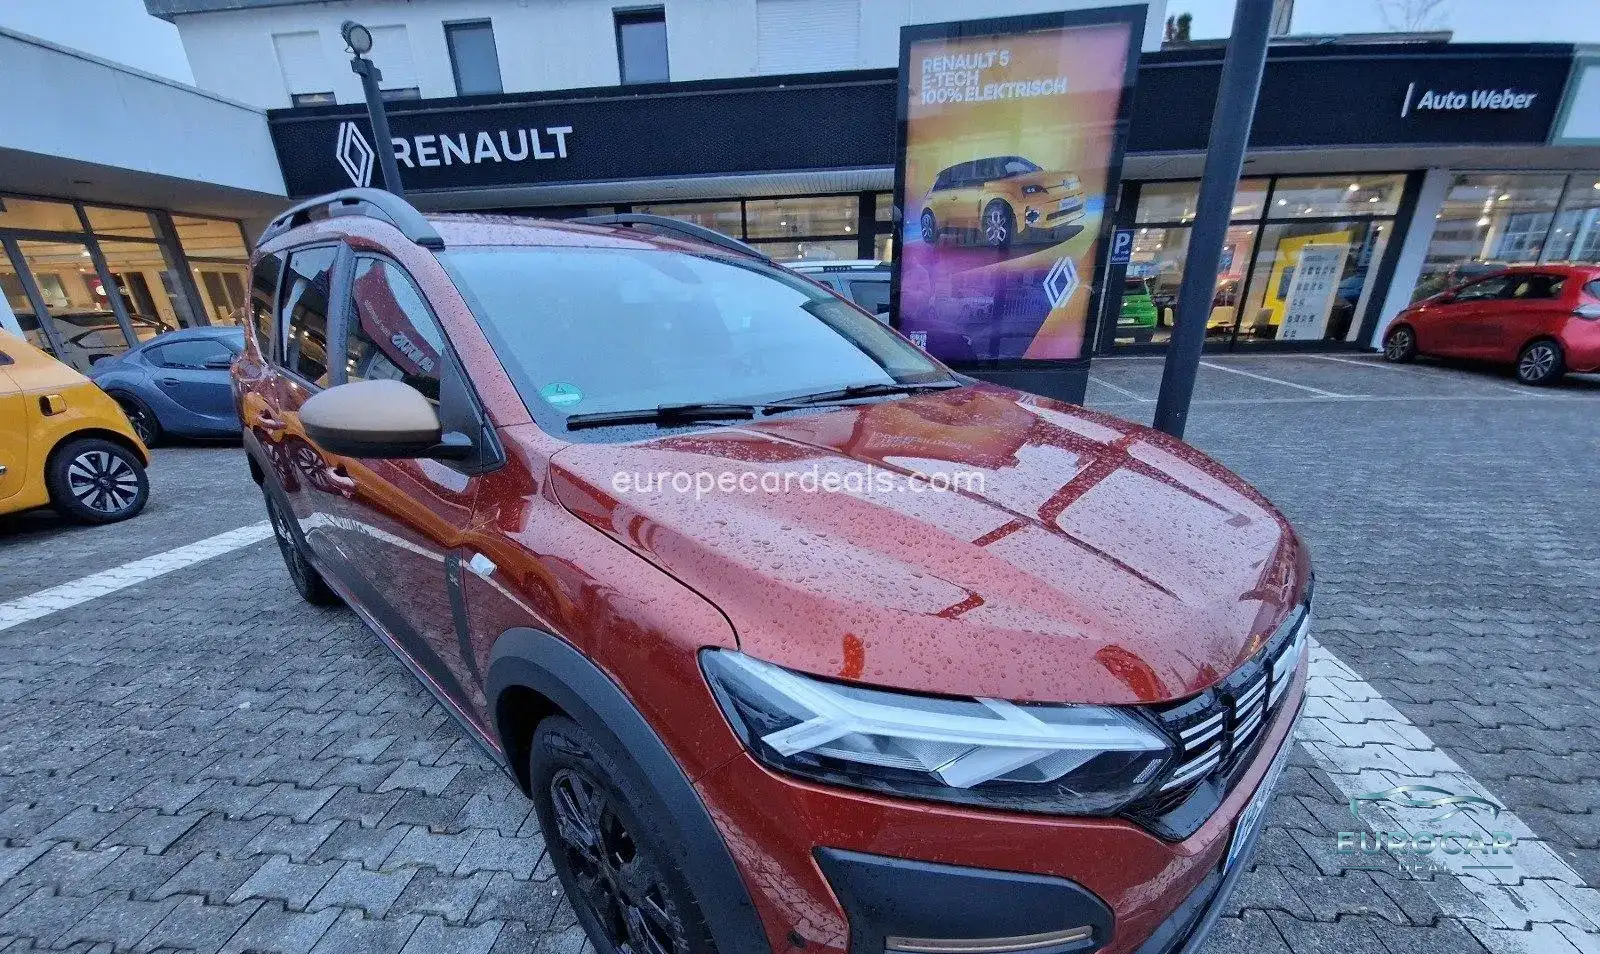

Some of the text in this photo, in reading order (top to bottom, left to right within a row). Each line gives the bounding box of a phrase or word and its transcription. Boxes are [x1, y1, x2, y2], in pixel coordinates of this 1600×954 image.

[922, 50, 1011, 72] RENAULT 5
[921, 70, 980, 90] E-TECH
[921, 77, 1067, 104] 100% ELEKTRISCH
[1417, 88, 1537, 110] Auto Weber
[391, 125, 573, 168] RENAULT
[1114, 233, 1130, 254] P
